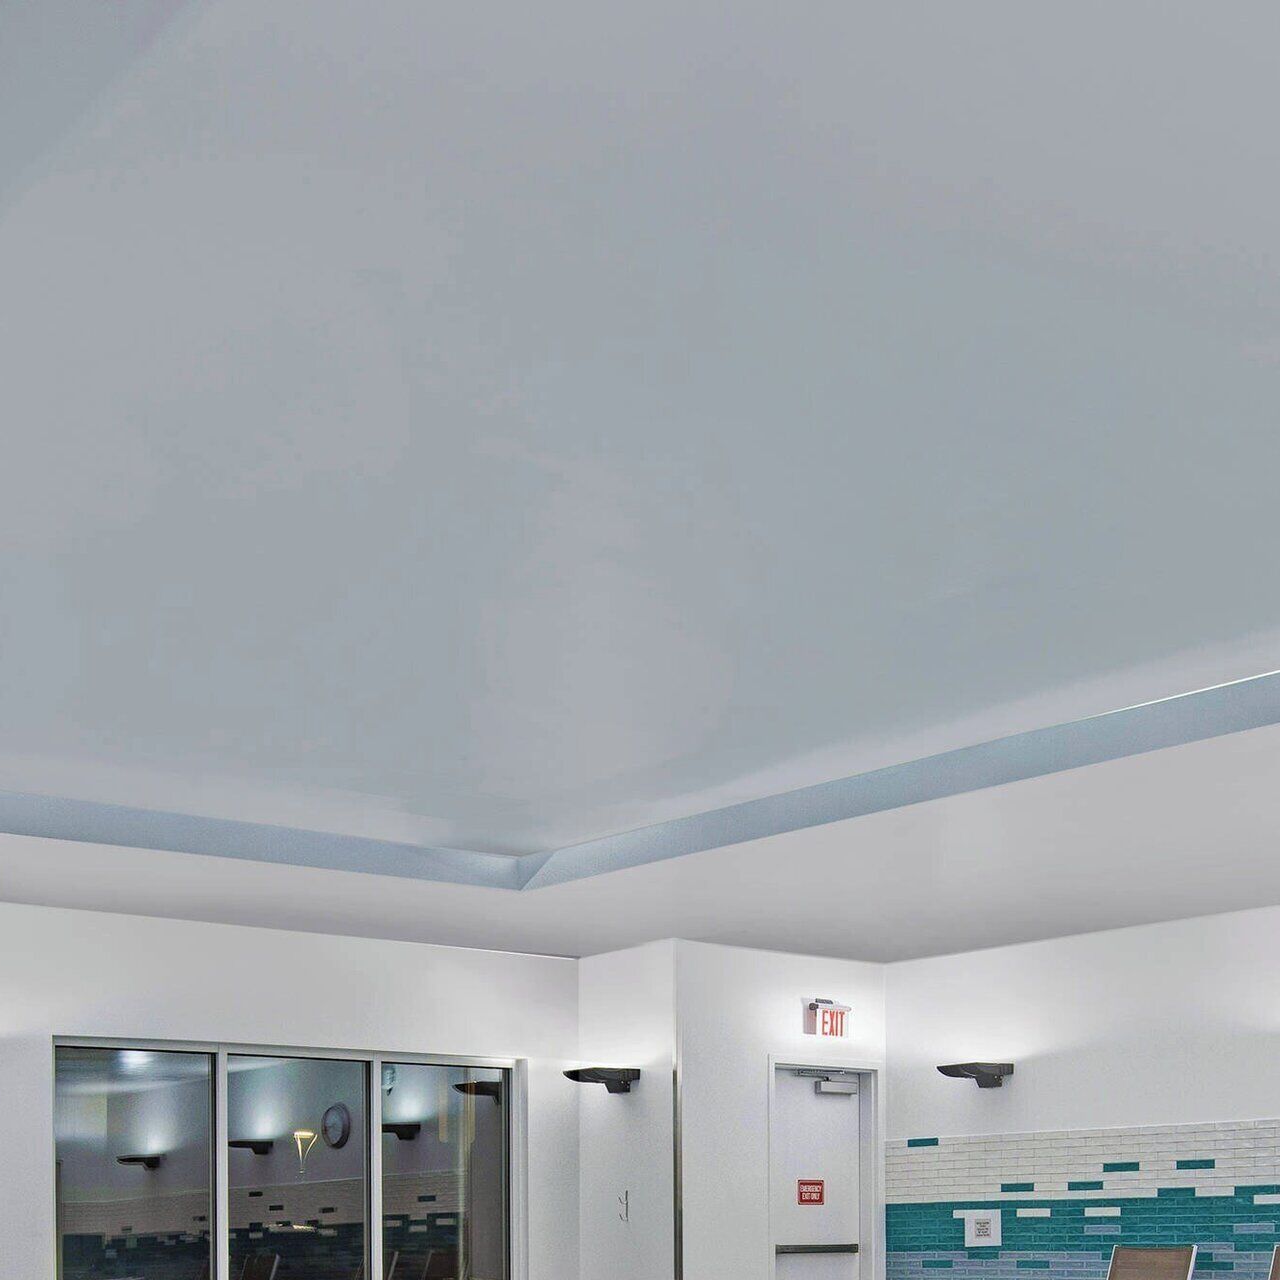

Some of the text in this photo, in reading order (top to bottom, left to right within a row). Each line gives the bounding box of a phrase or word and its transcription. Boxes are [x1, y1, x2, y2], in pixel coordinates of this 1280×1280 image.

[822, 1009, 845, 1037] EXIT
[800, 1184, 822, 1193] EMERGENCY
[802, 1192, 821, 1200] EXIT ONLY
